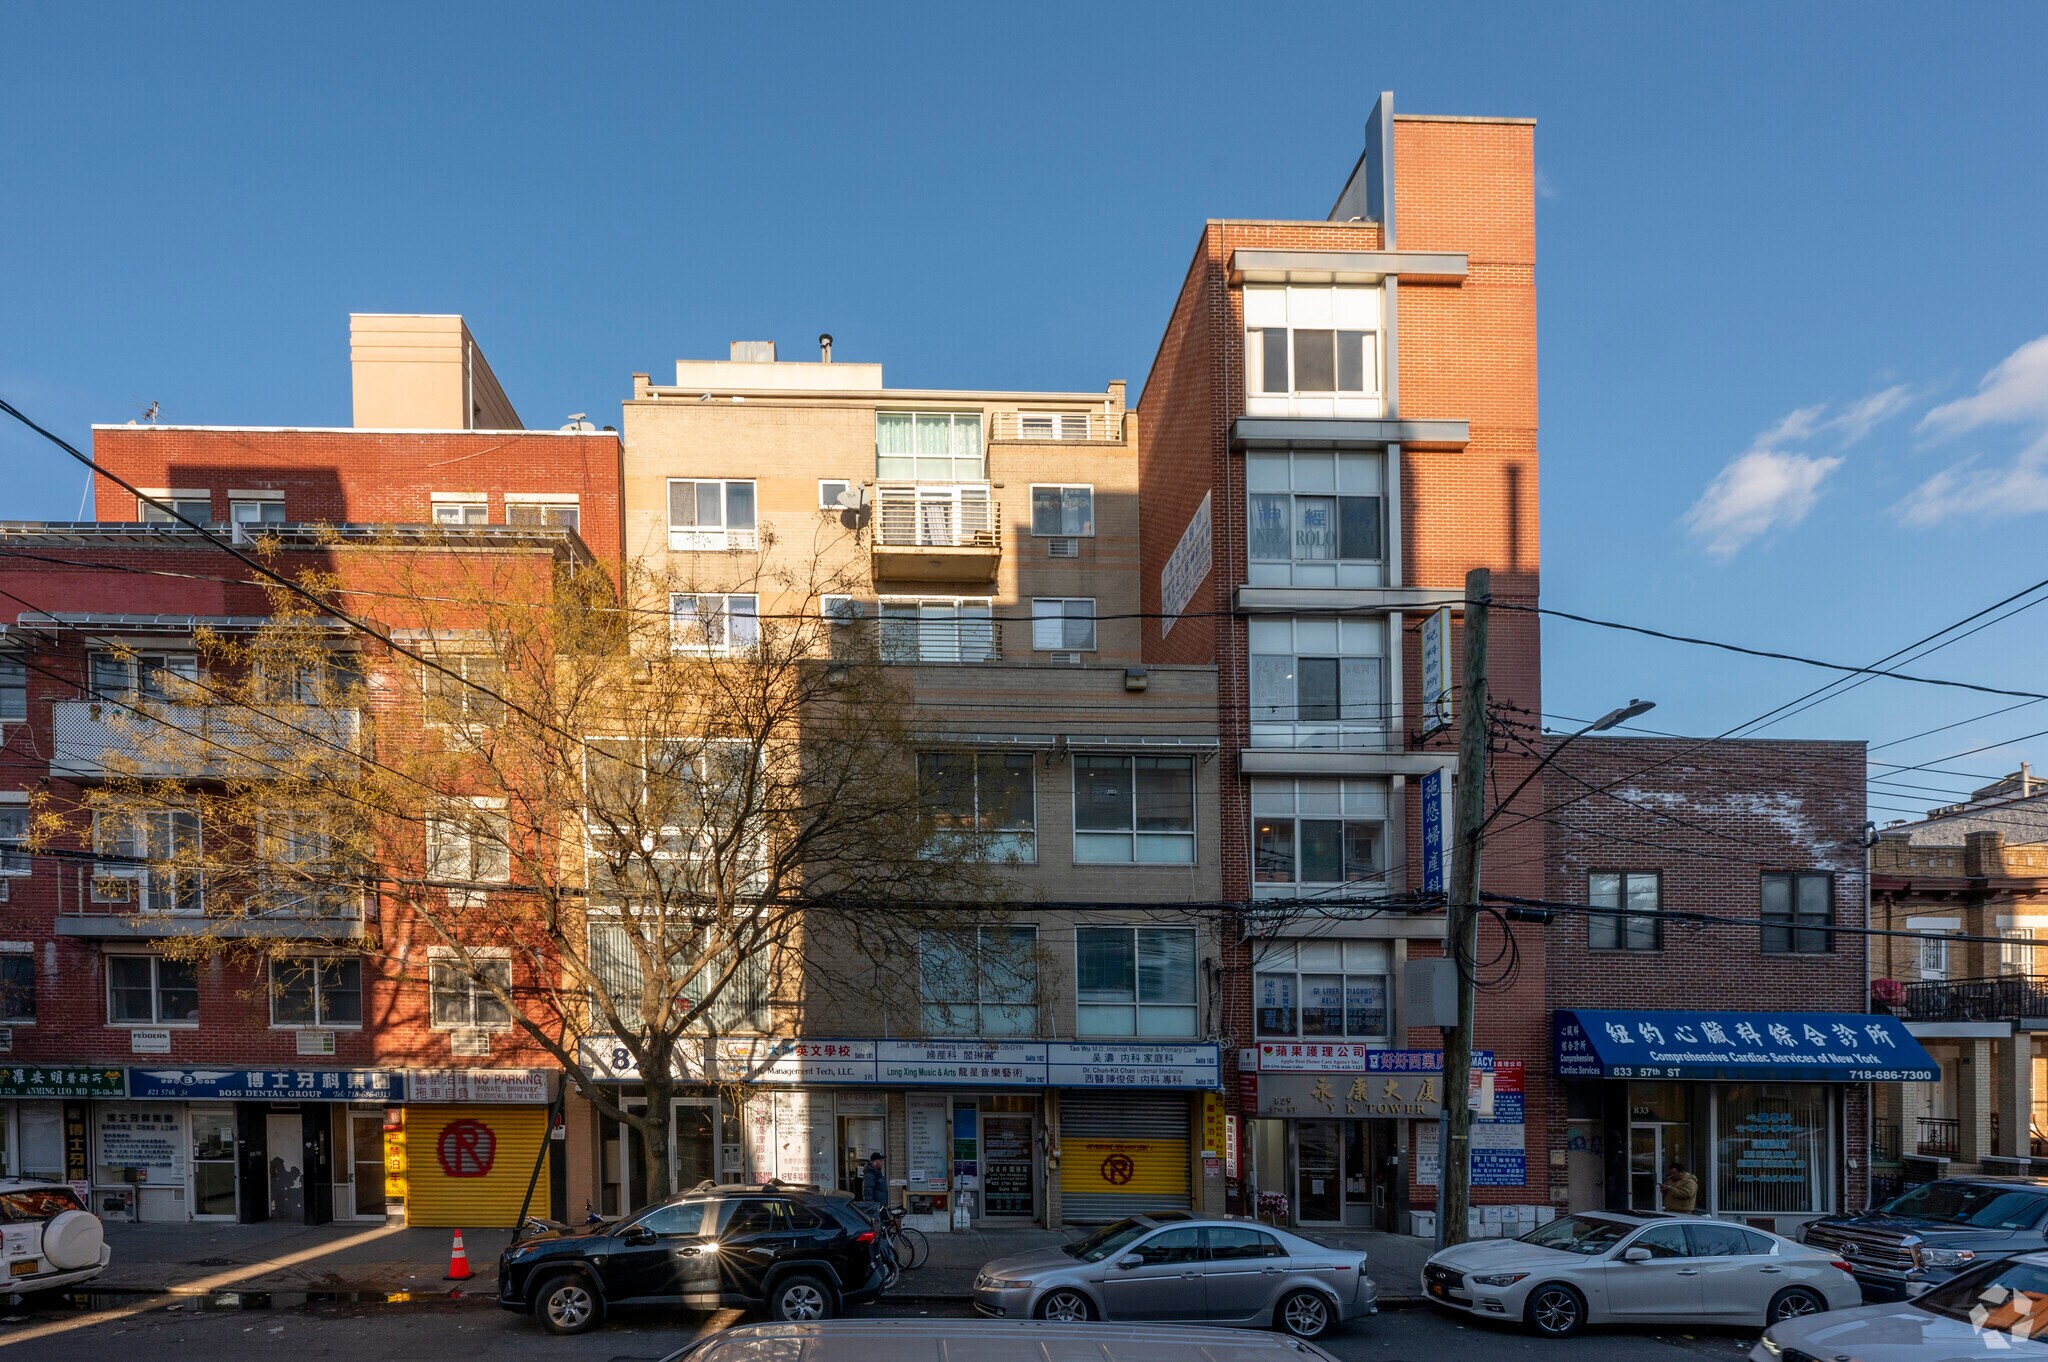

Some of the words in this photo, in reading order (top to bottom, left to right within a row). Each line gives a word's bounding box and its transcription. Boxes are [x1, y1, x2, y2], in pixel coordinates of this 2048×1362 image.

[1605, 1021, 1896, 1050] 紐約心臟科綜合診所
[1275, 1045, 1364, 1058] 蘋果護理公司
[1560, 1054, 1594, 1064] Comprehensive
[1649, 1051, 1729, 1063] Comprehensive
[1729, 1051, 1770, 1063] Cardiac
[1769, 1053, 1816, 1063] Services
[1817, 1053, 1829, 1063] of
[1828, 1054, 1853, 1063] New
[1853, 1054, 1882, 1064] York
[768, 1067, 813, 1076] Management
[817, 1068, 835, 1077] Tech,
[838, 1068, 854, 1076] LLC.
[887, 1068, 902, 1078] Long
[904, 1069, 918, 1078] Xing
[918, 1069, 936, 1077] Music
[937, 1069, 942, 1077] &
[944, 1069, 956, 1077] Arts
[958, 1066, 1023, 1078] 龍星音樂藝術
[1560, 1066, 1578, 1075] Cardiac
[1579, 1066, 1600, 1075] Services
[1613, 1068, 1632, 1077] 833
[1640, 1068, 1660, 1077] 57th
[1667, 1068, 1680, 1077] ST
[1849, 1070, 1931, 1080] 718-686-7300
[246, 1072, 390, 1090] 博士牙科集團
[474, 1074, 489, 1085] NO
[495, 1074, 541, 1085] PARKING
[161, 1088, 175, 1096] 57th
[245, 1090, 285, 1098] DENTAL
[1216, 1095, 1223, 1108] NO
[1346, 1104, 1356, 1114] K
[1366, 1104, 1425, 1114] TOWER
[1634, 1106, 1649, 1114] 833
[389, 1133, 400, 1182] 严禁泊车
